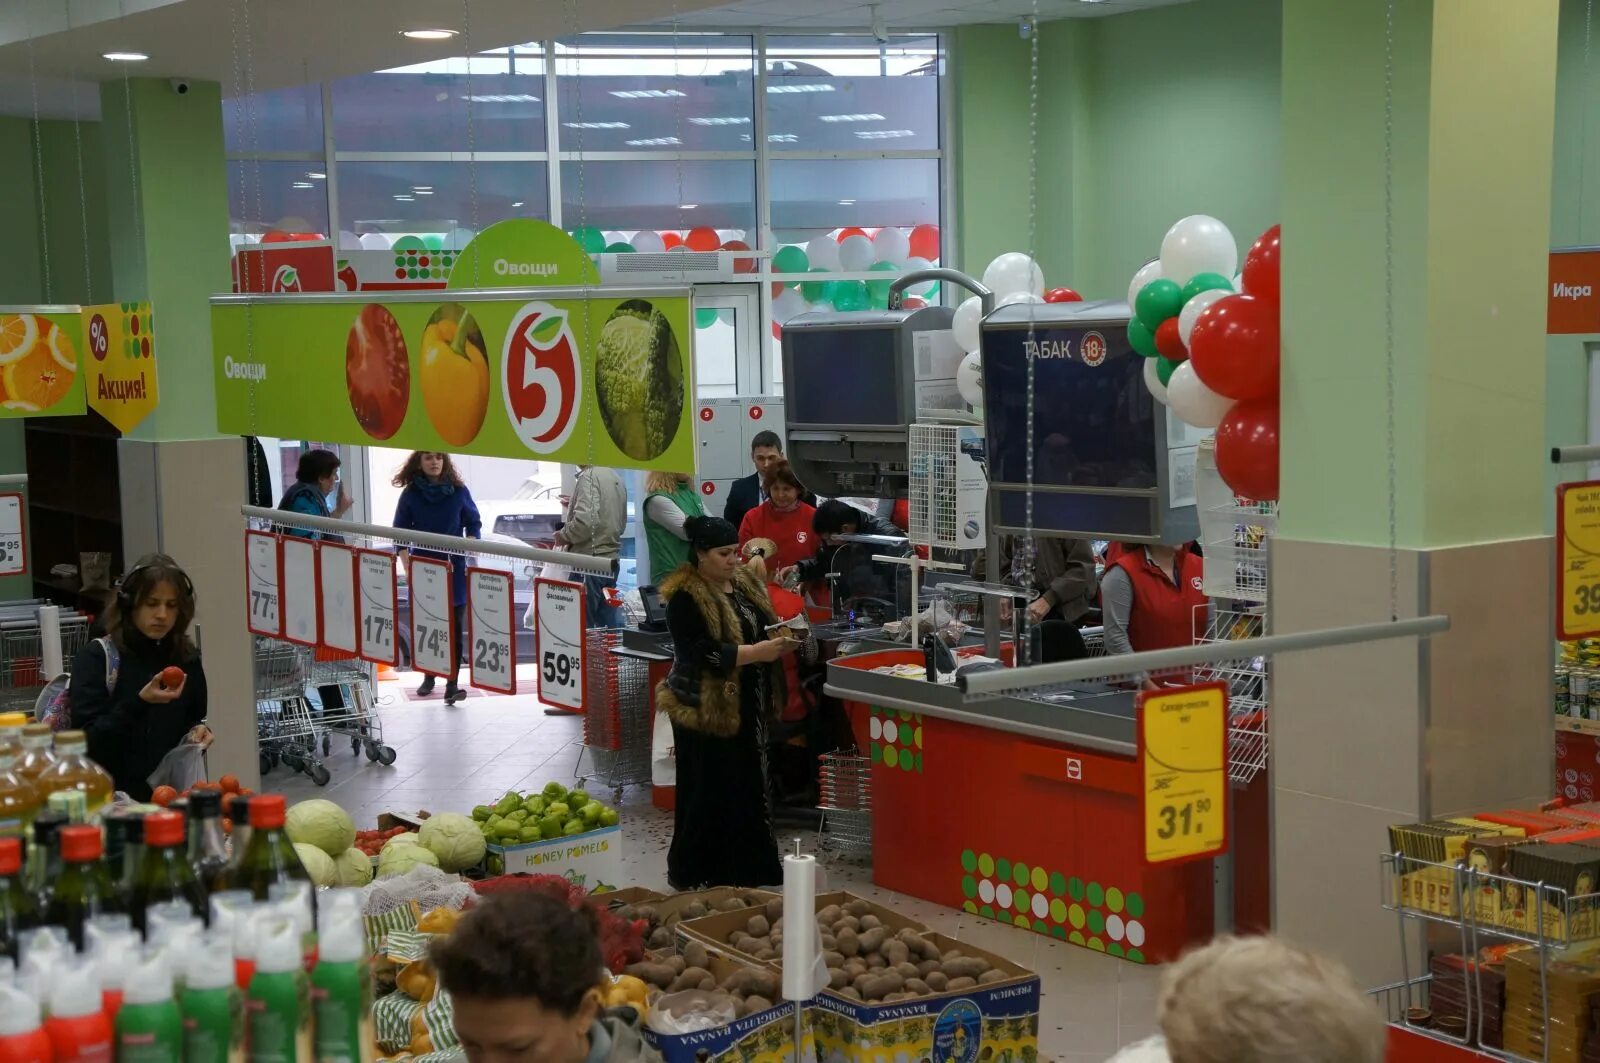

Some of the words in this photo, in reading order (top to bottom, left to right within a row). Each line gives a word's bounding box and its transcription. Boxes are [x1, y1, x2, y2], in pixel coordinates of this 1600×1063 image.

[494, 258, 559, 278] Овощи
[1553, 282, 1592, 301] Икра
[1022, 340, 1072, 359] ТАБАК
[223, 355, 267, 383] Овощи
[98, 372, 147, 404] Акция!
[526, 850, 564, 866] HONEY
[567, 840, 609, 859] POMELO
[990, 985, 1032, 1001] PREMIUM
[736, 1003, 796, 1032] ORMIGUITA
[879, 1004, 928, 1019] BANANAS
[680, 1025, 732, 1046] BANANA
